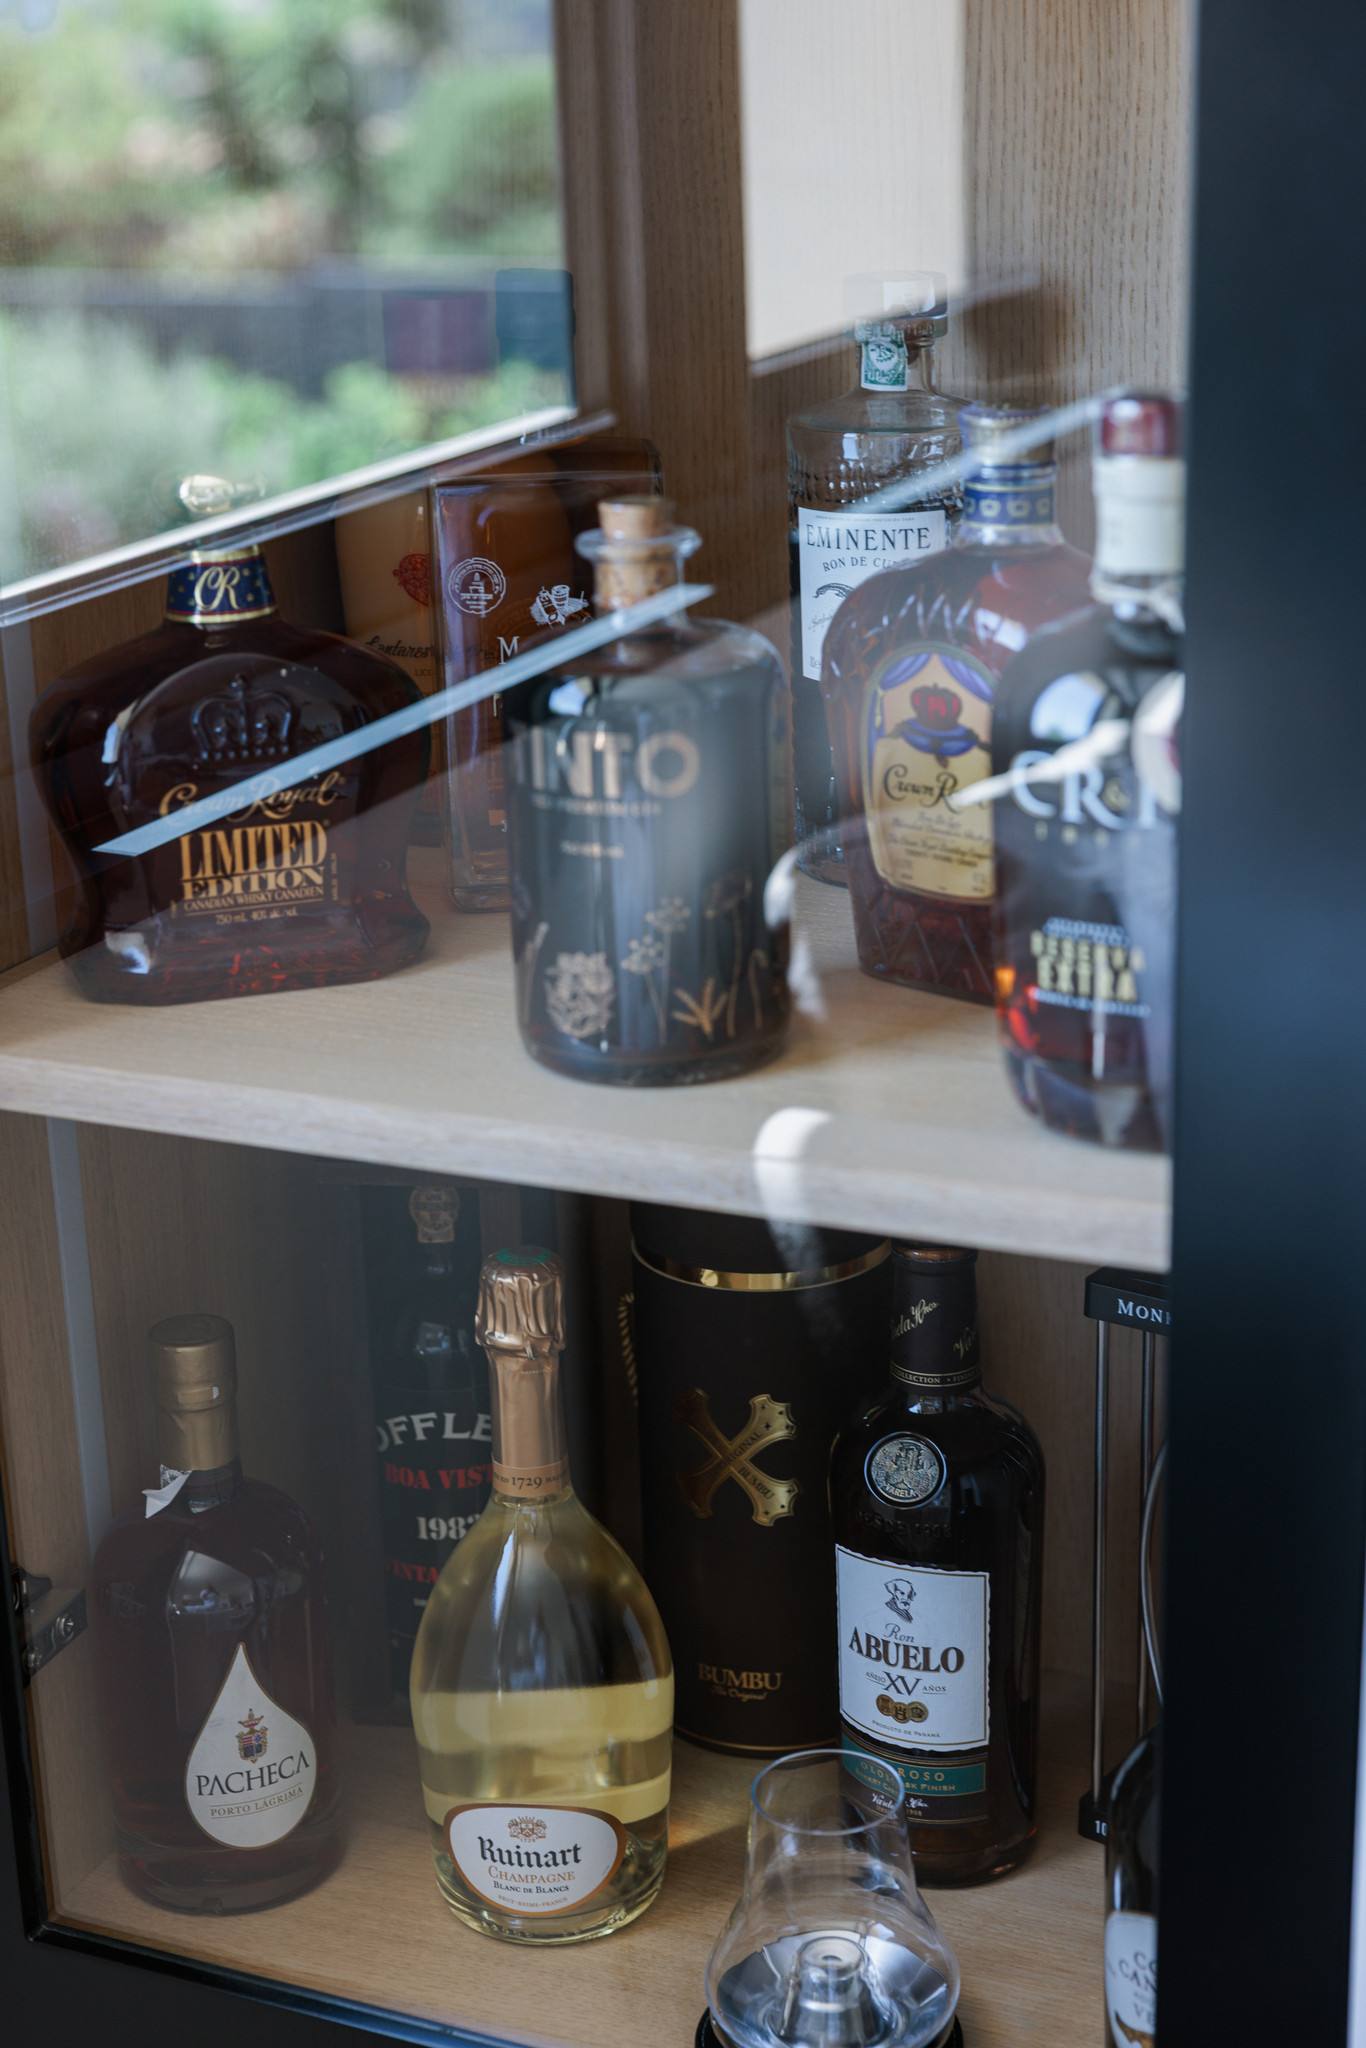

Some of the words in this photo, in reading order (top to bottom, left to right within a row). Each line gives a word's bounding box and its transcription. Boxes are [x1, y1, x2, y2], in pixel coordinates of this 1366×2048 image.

[806, 523, 931, 550] EMINENTE
[822, 557, 846, 572] RON
[851, 556, 867, 567] DE
[884, 764, 935, 802] Crown
[180, 820, 328, 879] LIMITED
[182, 866, 325, 900] EDITION
[184, 896, 235, 911] CANADIAN
[237, 891, 273, 906] WHISKY
[275, 886, 324, 901] CANADIEN
[1037, 953, 1138, 1003] EXTRA
[376, 1412, 492, 1452] FFLE
[437, 1463, 493, 1489] VIST
[511, 1476, 543, 1489] 1729
[884, 1622, 915, 1643] Ron
[849, 1626, 965, 1673] ABUELO
[699, 1664, 782, 1690] BUMBU
[883, 1671, 922, 1696] XV
[923, 1683, 947, 1693] AÑOS
[195, 1750, 310, 1796] PACHECA
[210, 1804, 250, 1817] PORTO
[477, 1836, 582, 1868] Ruinart
[488, 1865, 575, 1884] CHAMPAGNE
[493, 1880, 520, 1893] BLANC
[523, 1886, 532, 1894] DE
[535, 1884, 569, 1894] BLANCS
